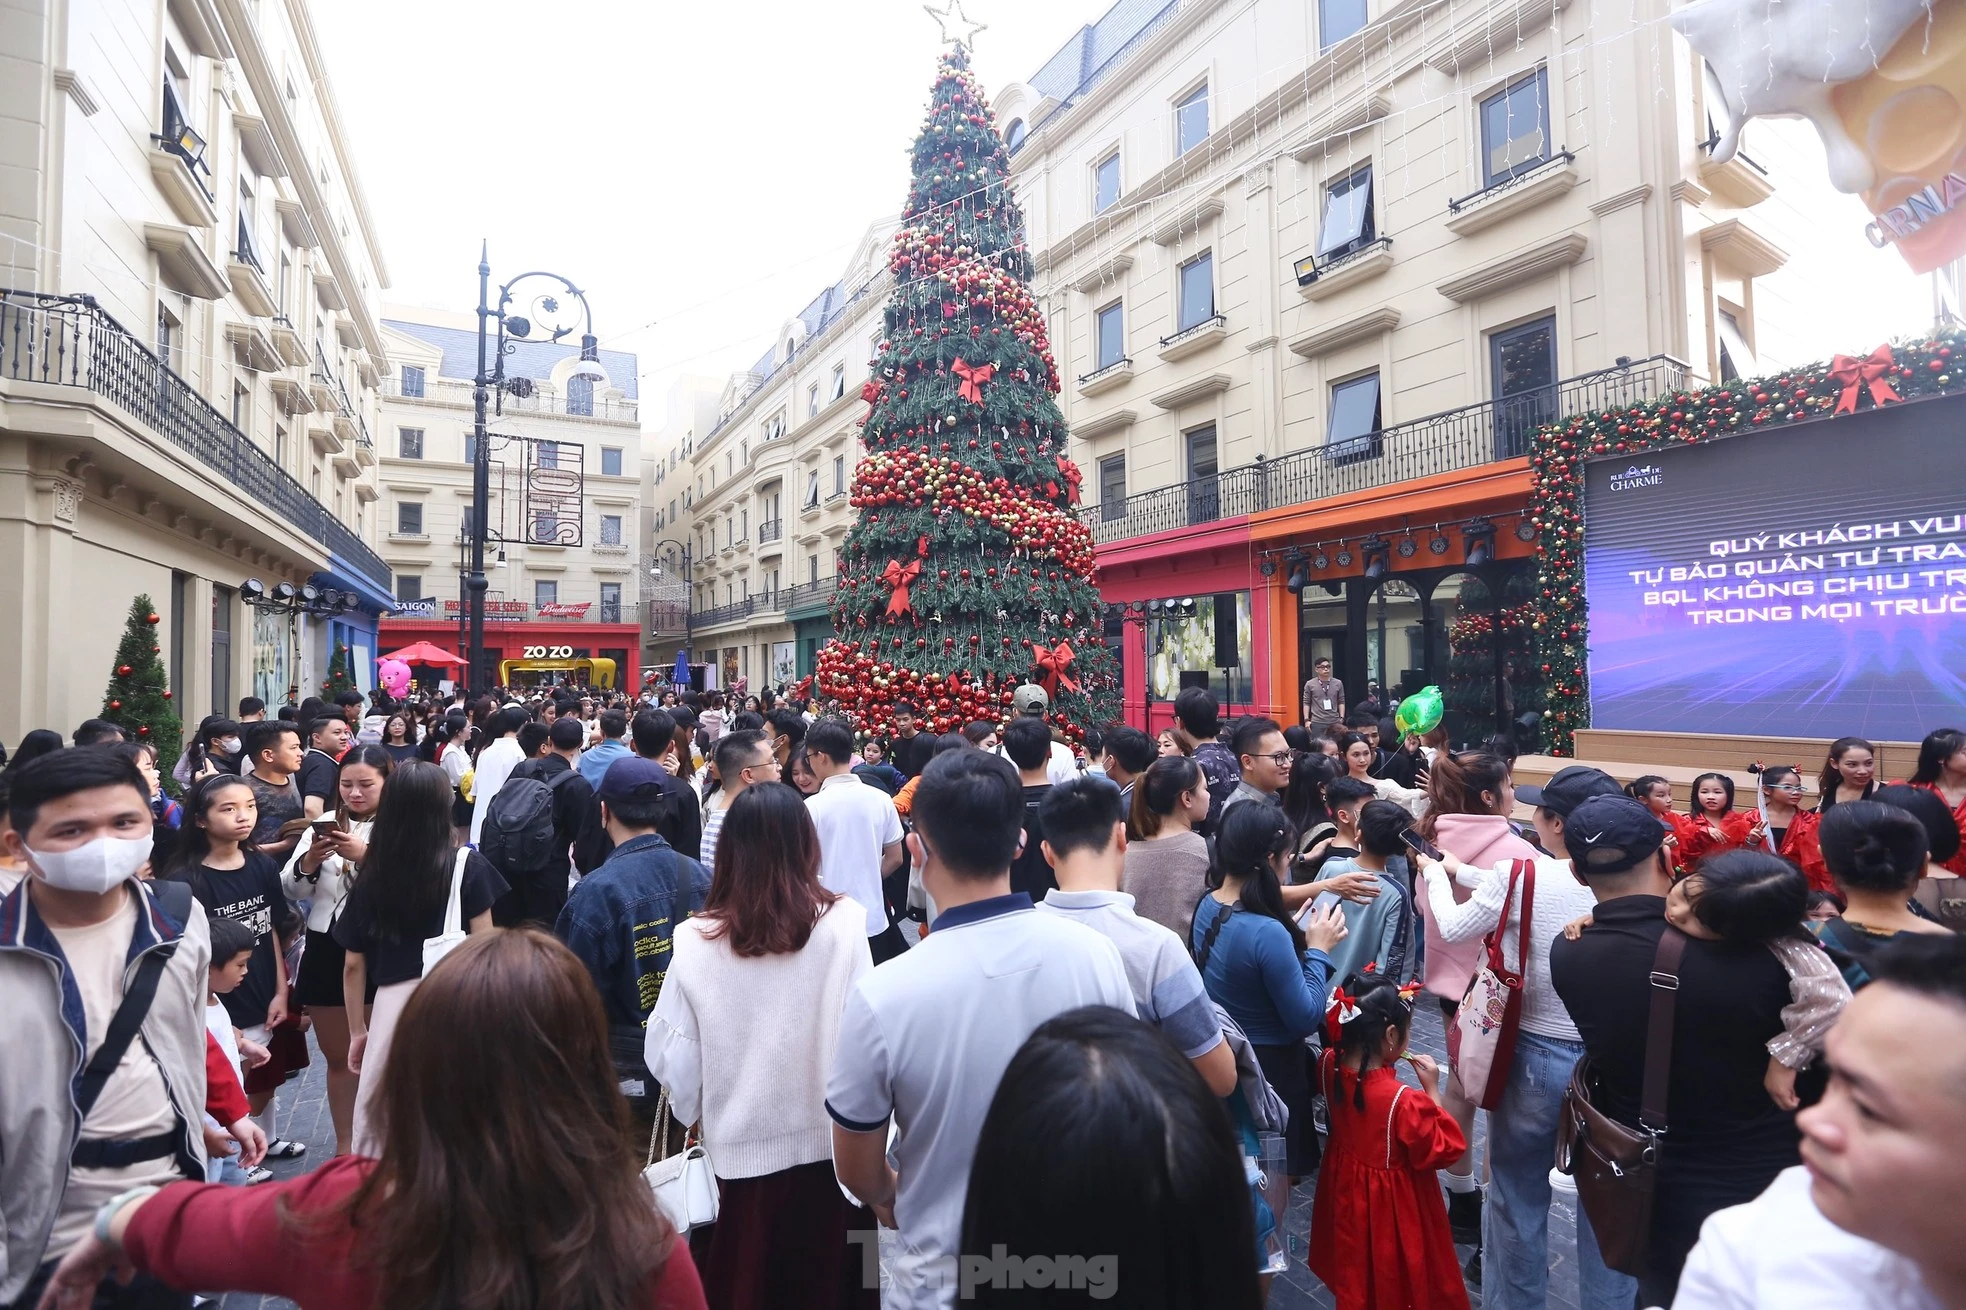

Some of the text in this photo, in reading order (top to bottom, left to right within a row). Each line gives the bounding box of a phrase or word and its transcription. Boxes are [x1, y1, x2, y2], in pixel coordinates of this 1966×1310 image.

[1610, 475, 1662, 491] CHARME
[1709, 531, 1770, 557] QUÝ
[1778, 522, 1900, 549] KHÁCH
[1629, 566, 1664, 587] TỰ
[1670, 561, 1727, 582] BẢO
[1734, 553, 1824, 579] QUẢN
[1832, 547, 1881, 569] TƯ
[1643, 590, 1698, 607] BQL
[1703, 580, 1815, 602] KHÔNG
[1824, 571, 1911, 595] CHỊU
[394, 602, 435, 611] SAIGON
[541, 604, 588, 614] Budweiser
[1686, 606, 1793, 625] TRONG
[1801, 602, 1862, 623] MỌI
[523, 646, 573, 659] ZO ZO
[214, 903, 237, 917] THE
